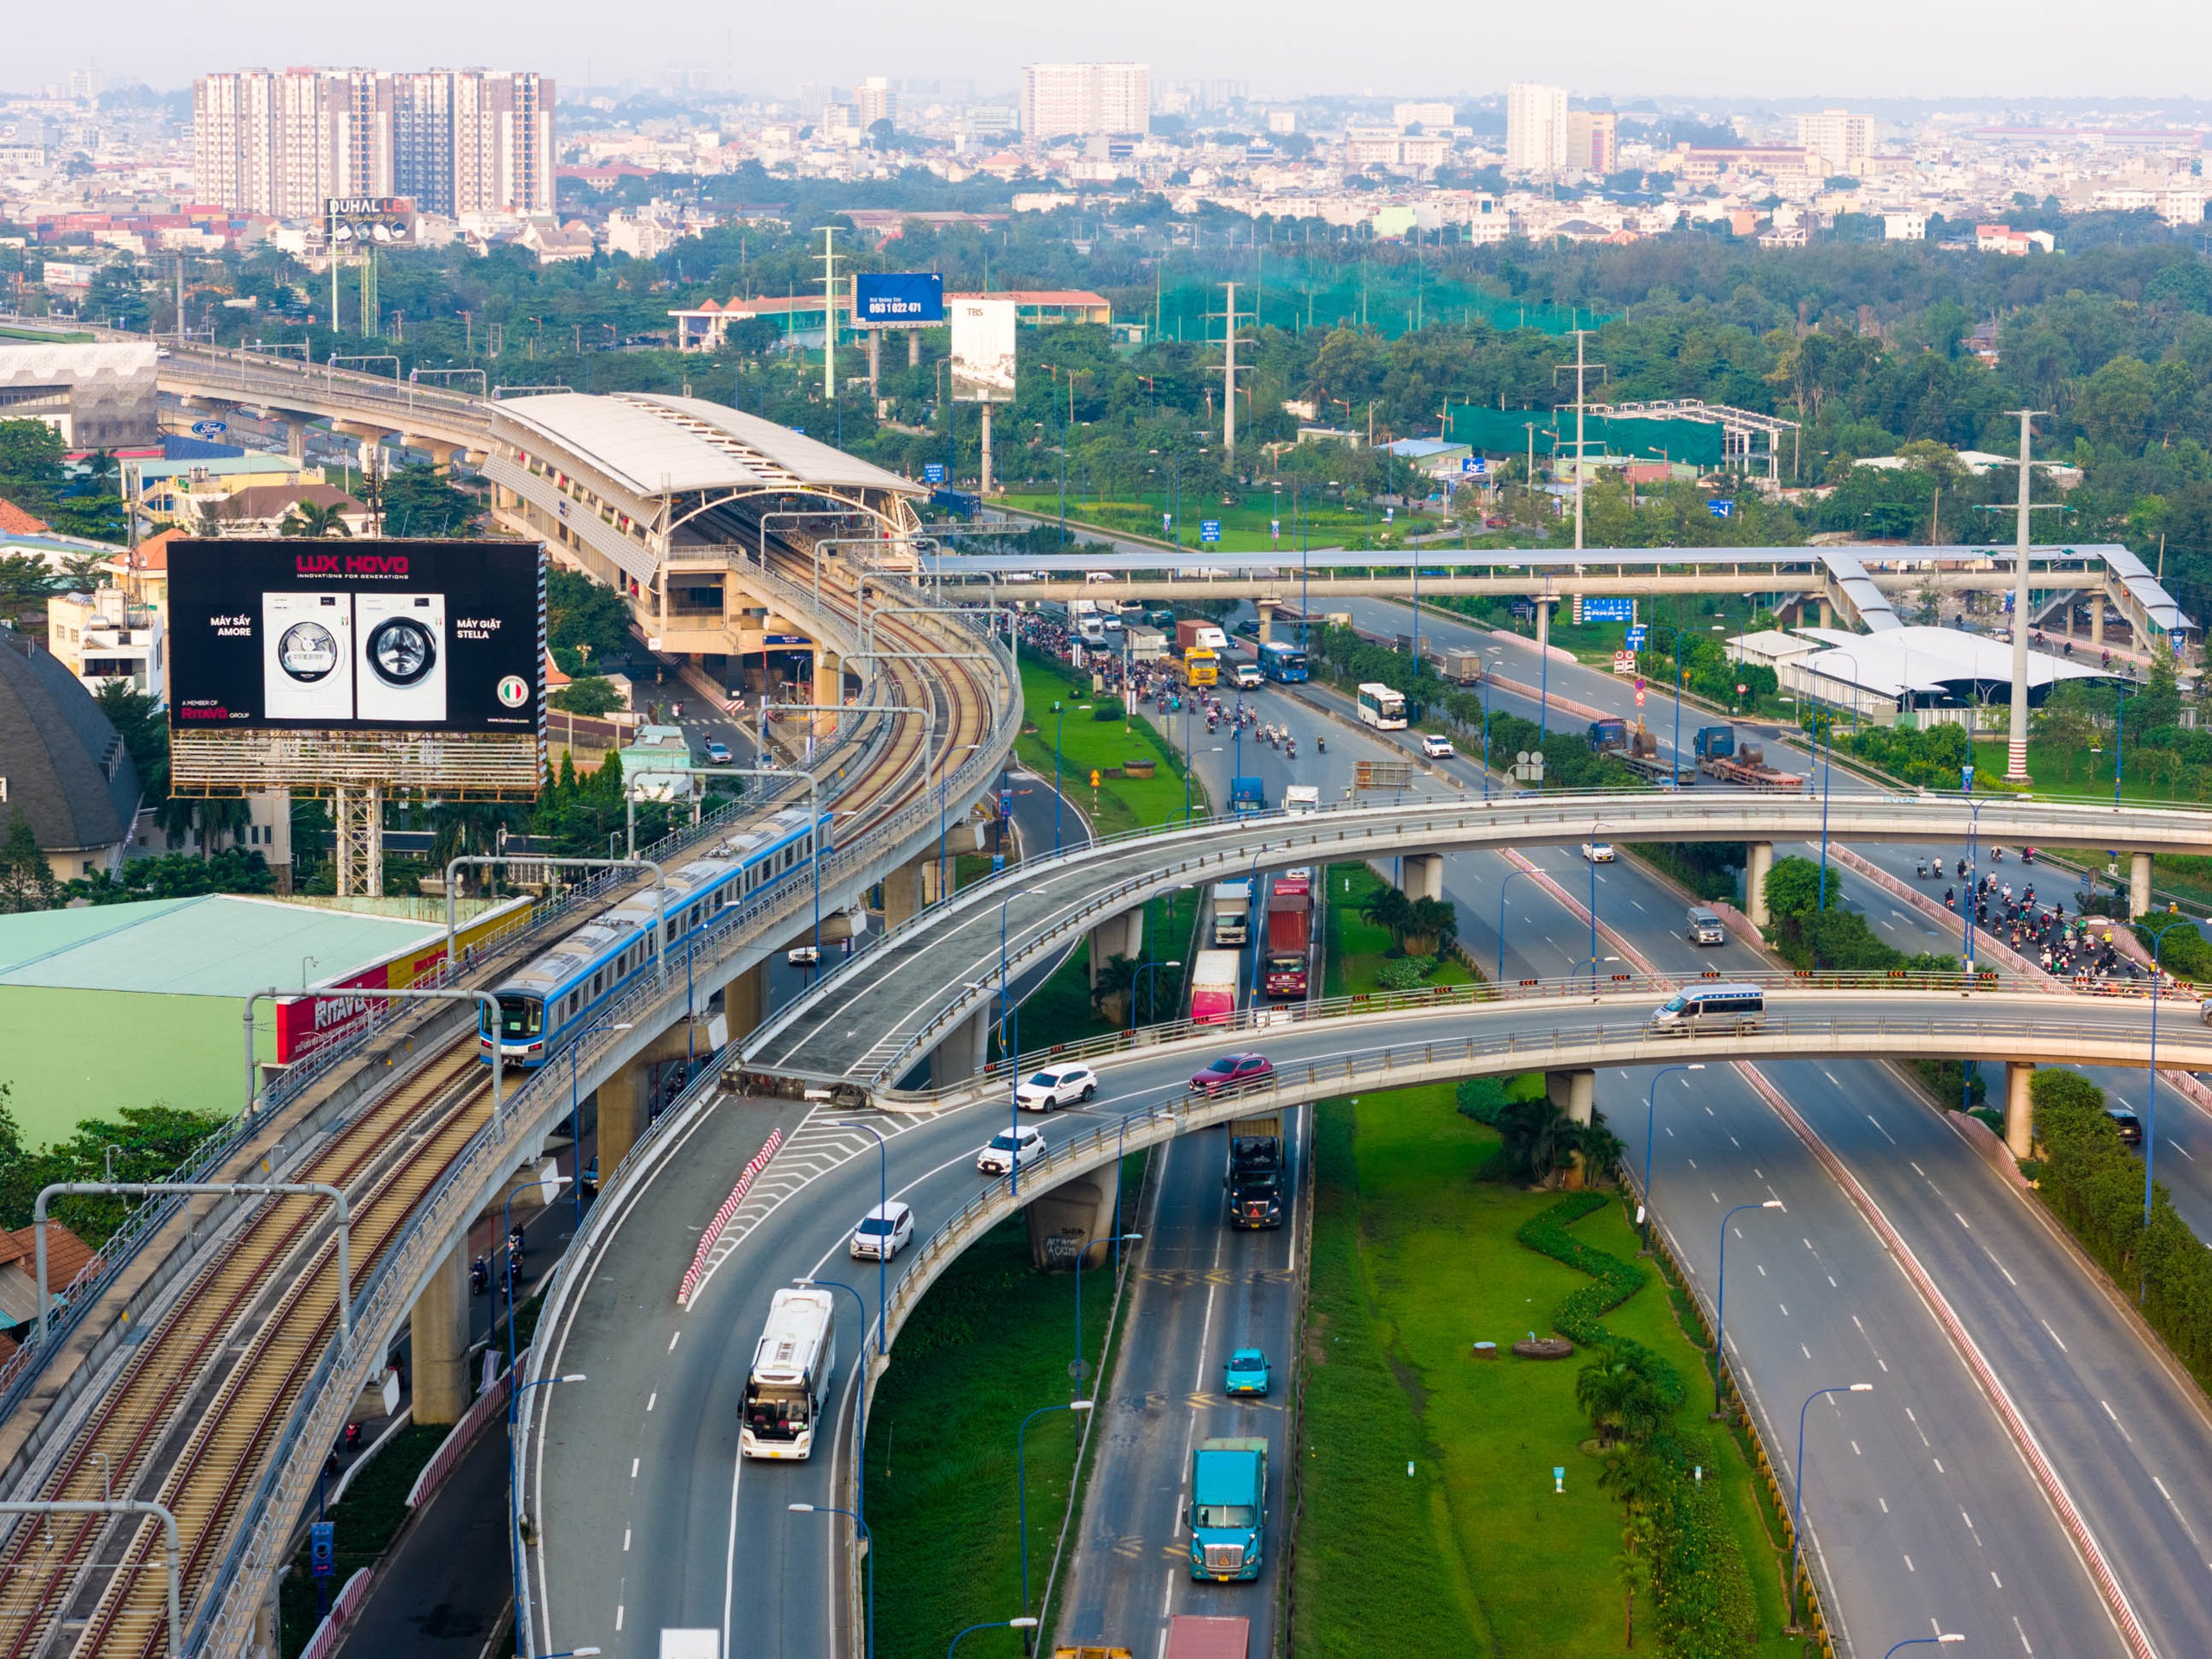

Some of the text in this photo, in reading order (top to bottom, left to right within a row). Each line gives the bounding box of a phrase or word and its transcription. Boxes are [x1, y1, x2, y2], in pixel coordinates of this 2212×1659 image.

[329, 200, 413, 213] DUHAL LED
[966, 308, 983, 316] TBS
[200, 423, 222, 433] Ford
[296, 555, 409, 573] LUX HOVO
[210, 614, 232, 626] MÁY
[456, 617, 478, 629] MÁY
[217, 627, 251, 637] AMORE
[456, 630, 489, 639] STELLA
